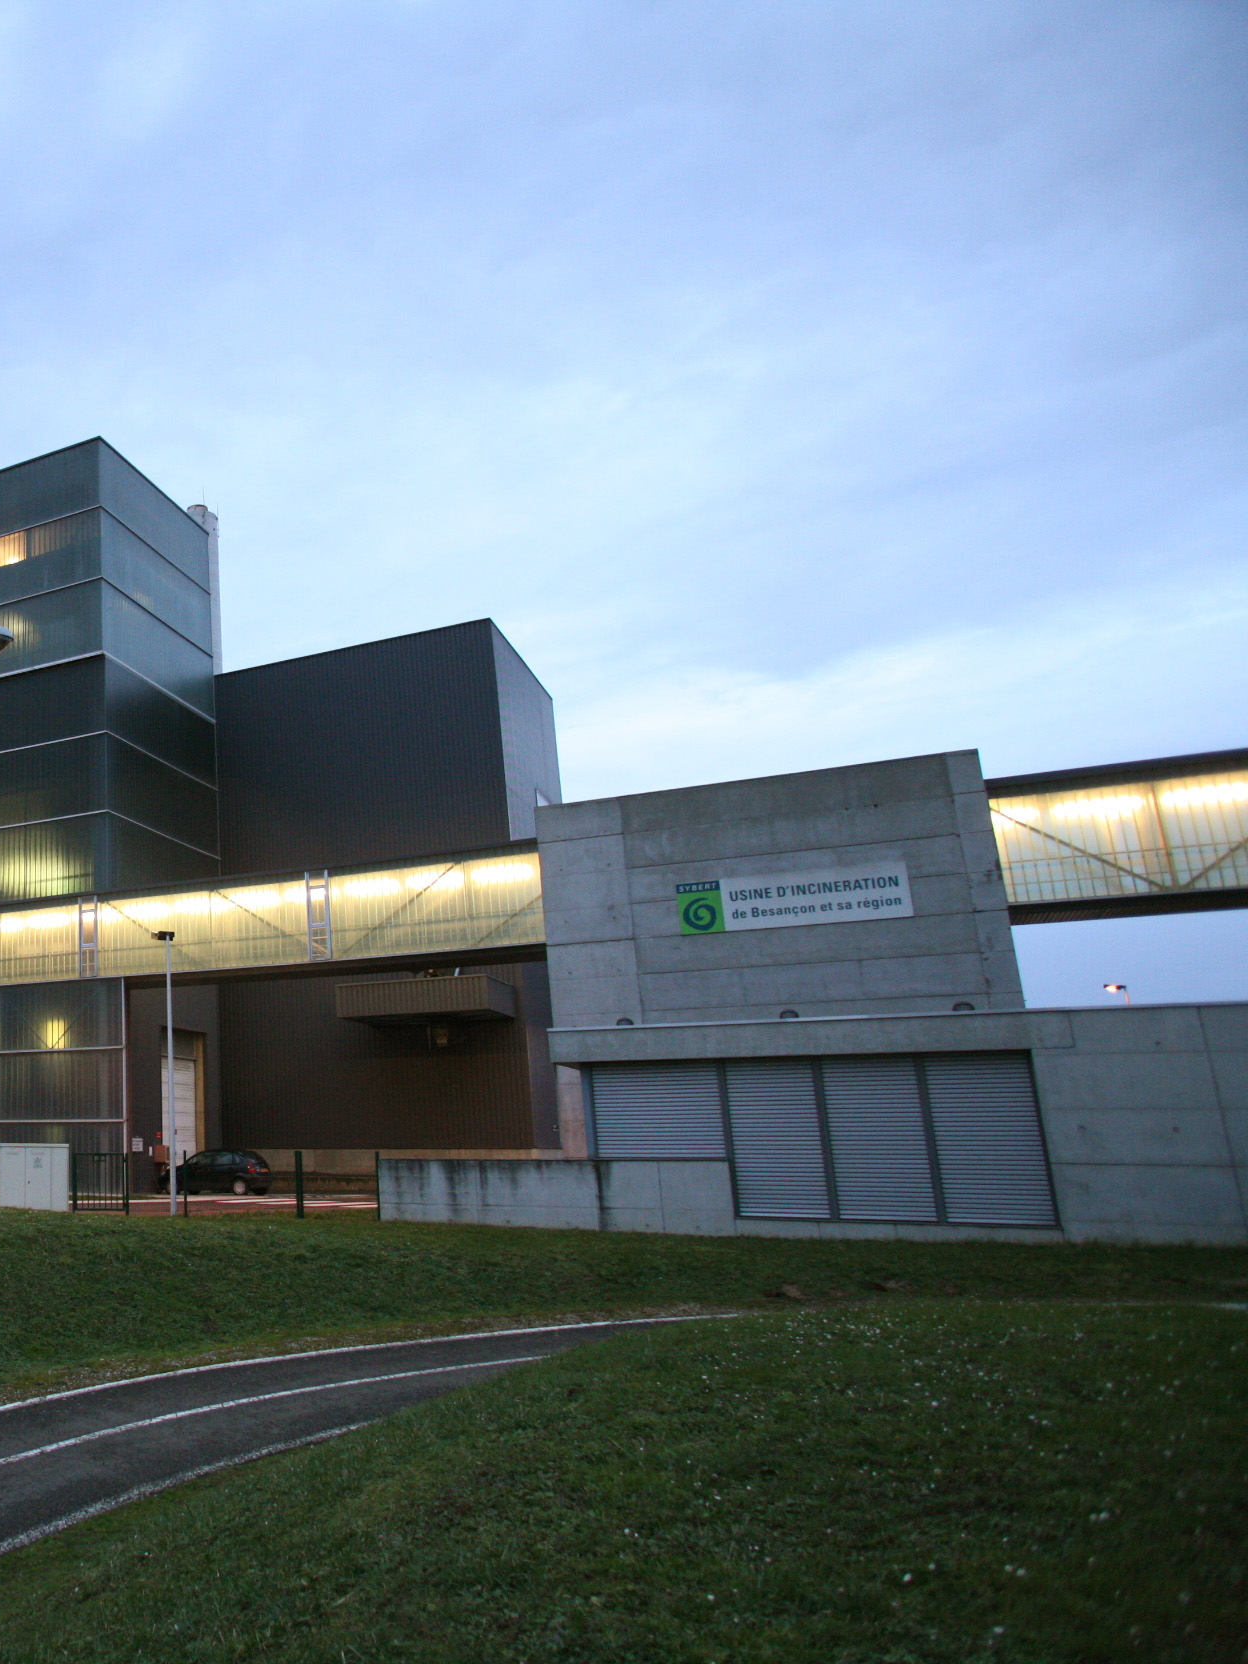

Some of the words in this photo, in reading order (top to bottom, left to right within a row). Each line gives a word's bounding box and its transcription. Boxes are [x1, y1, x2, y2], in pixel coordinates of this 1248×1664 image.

[678, 883, 717, 893] SYBERT
[729, 887, 773, 902] USINE
[776, 875, 900, 898] D'INCINERATION
[732, 908, 747, 919] de
[751, 904, 816, 918] Besançon
[820, 901, 834, 912] et
[837, 901, 853, 911] sa
[857, 896, 902, 910] région
